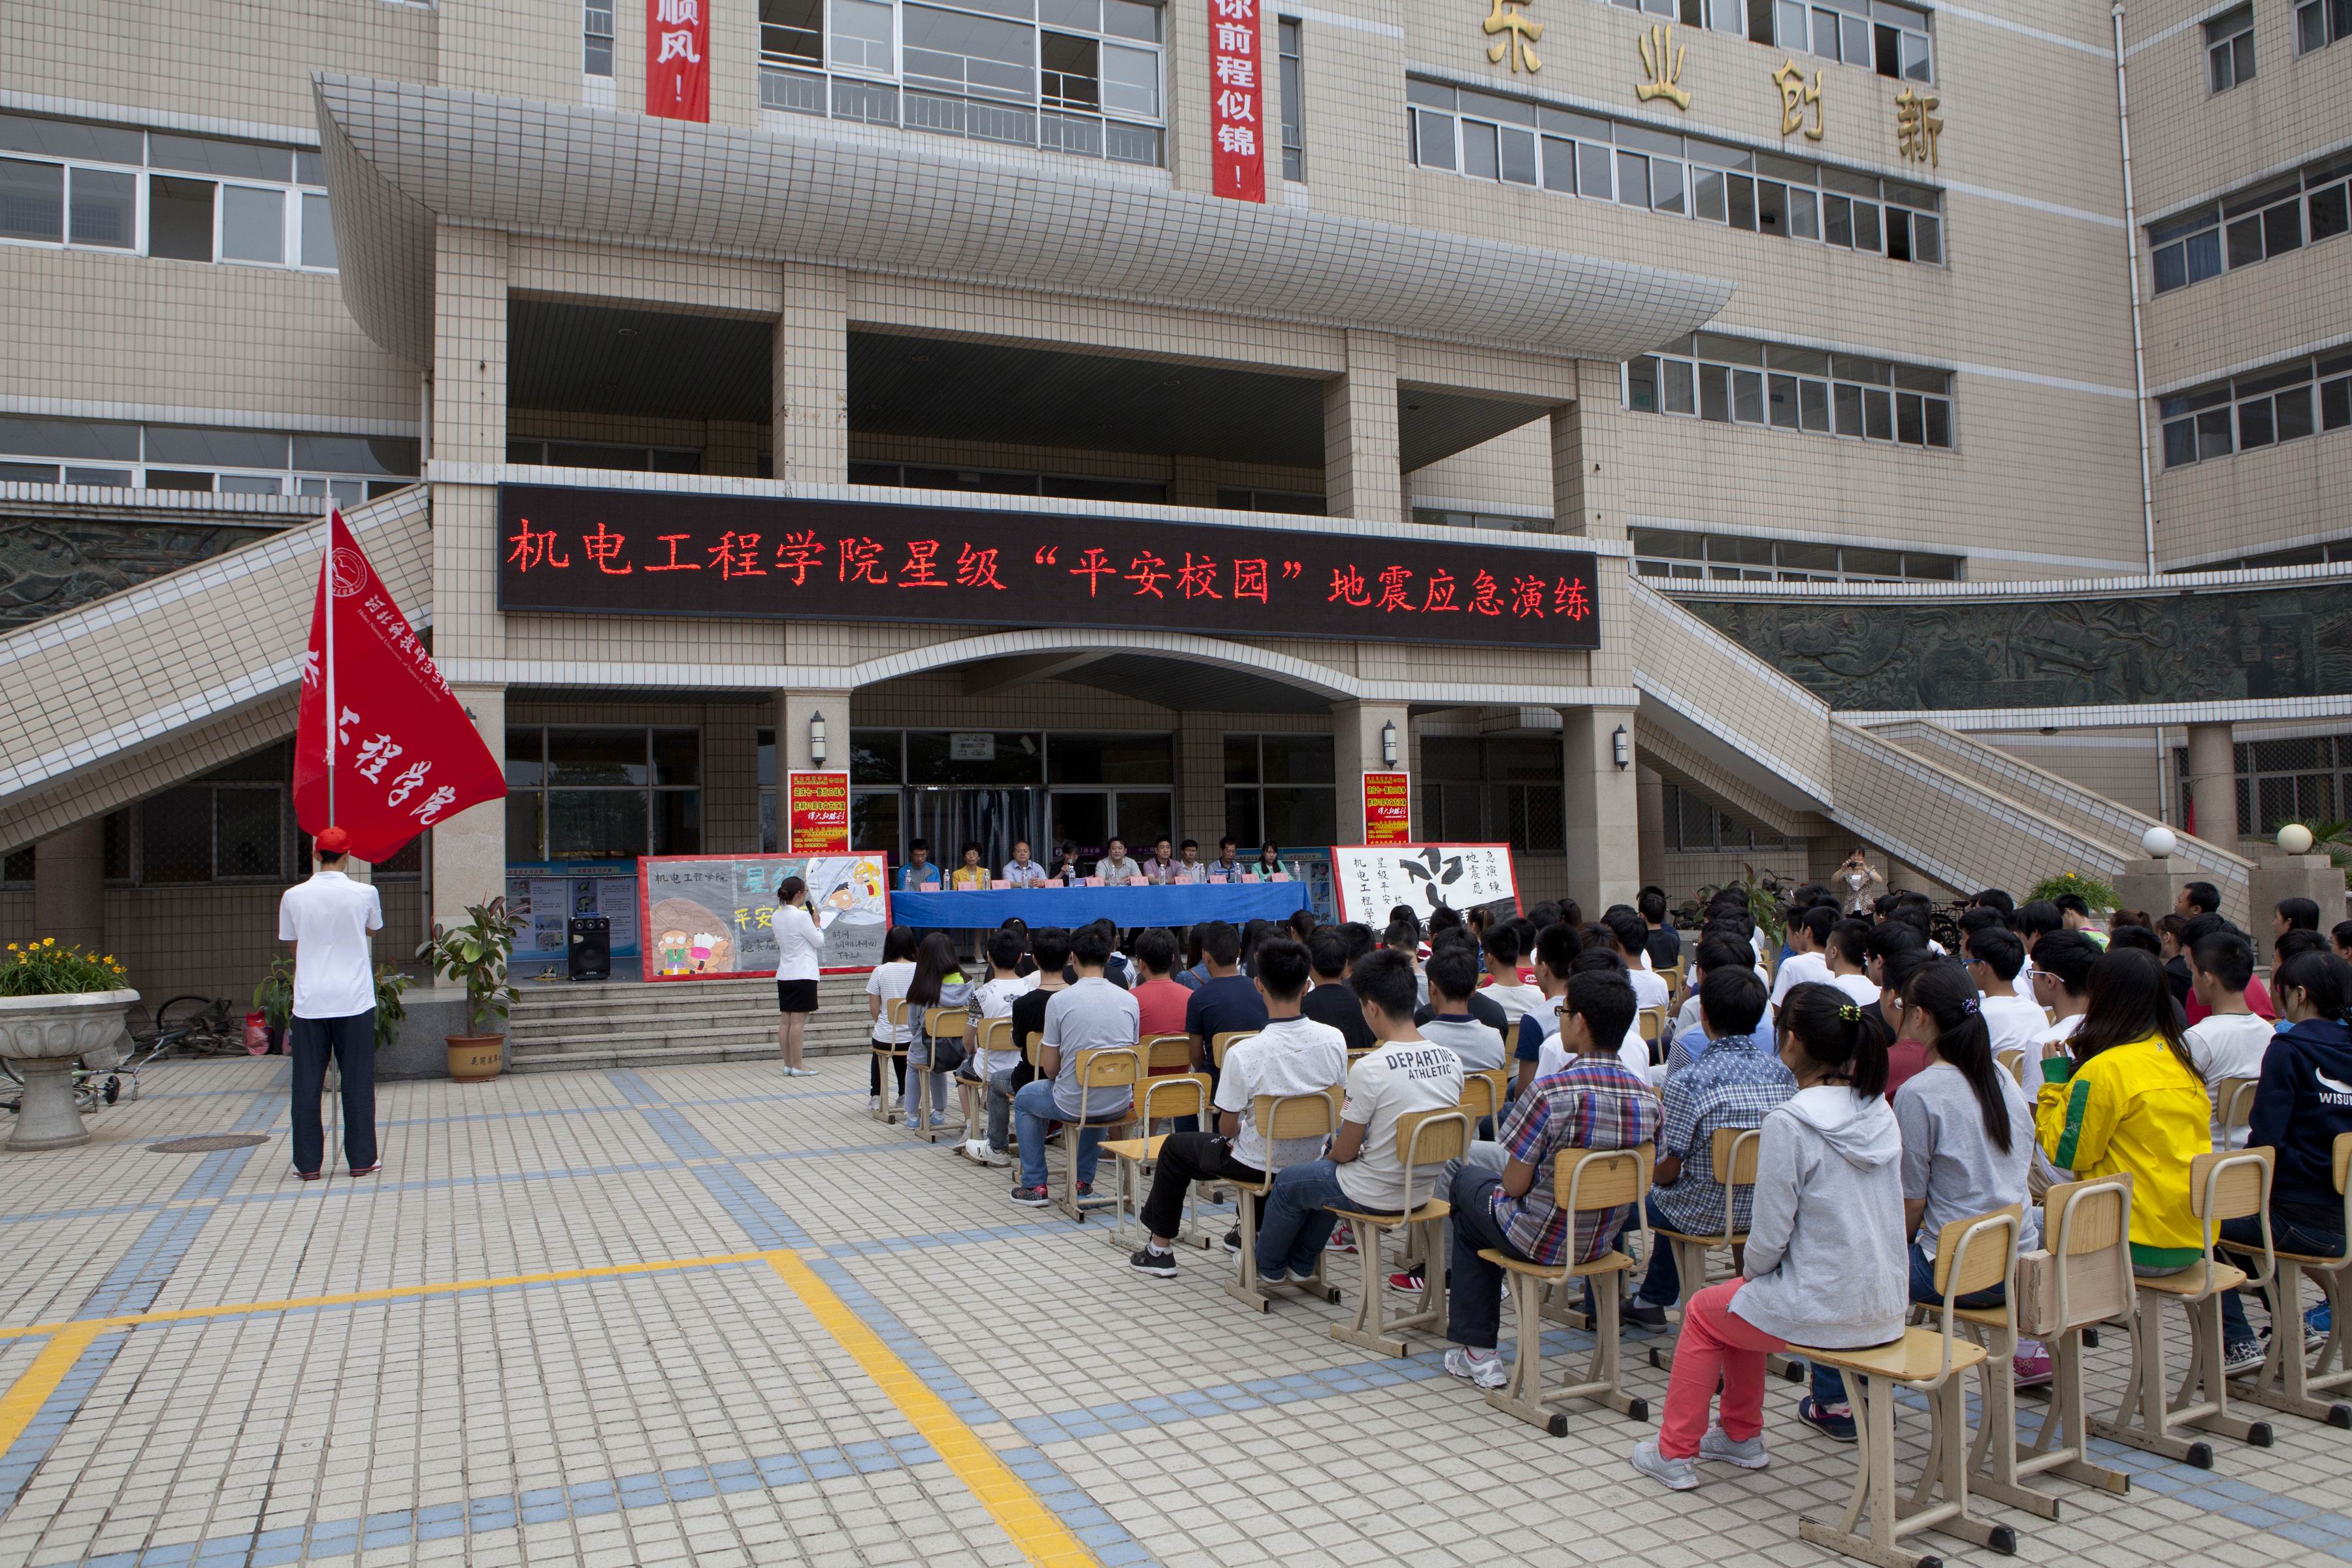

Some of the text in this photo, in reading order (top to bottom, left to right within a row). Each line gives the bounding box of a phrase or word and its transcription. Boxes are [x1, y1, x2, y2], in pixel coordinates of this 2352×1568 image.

[357, 608, 370, 623] Hebei
[369, 623, 385, 641] Normal
[384, 640, 402, 661] University
[655, 872, 728, 884] 机电工程学院
[741, 938, 780, 953] 地震应
[1409, 1064, 1452, 1079] ATHLETIC
